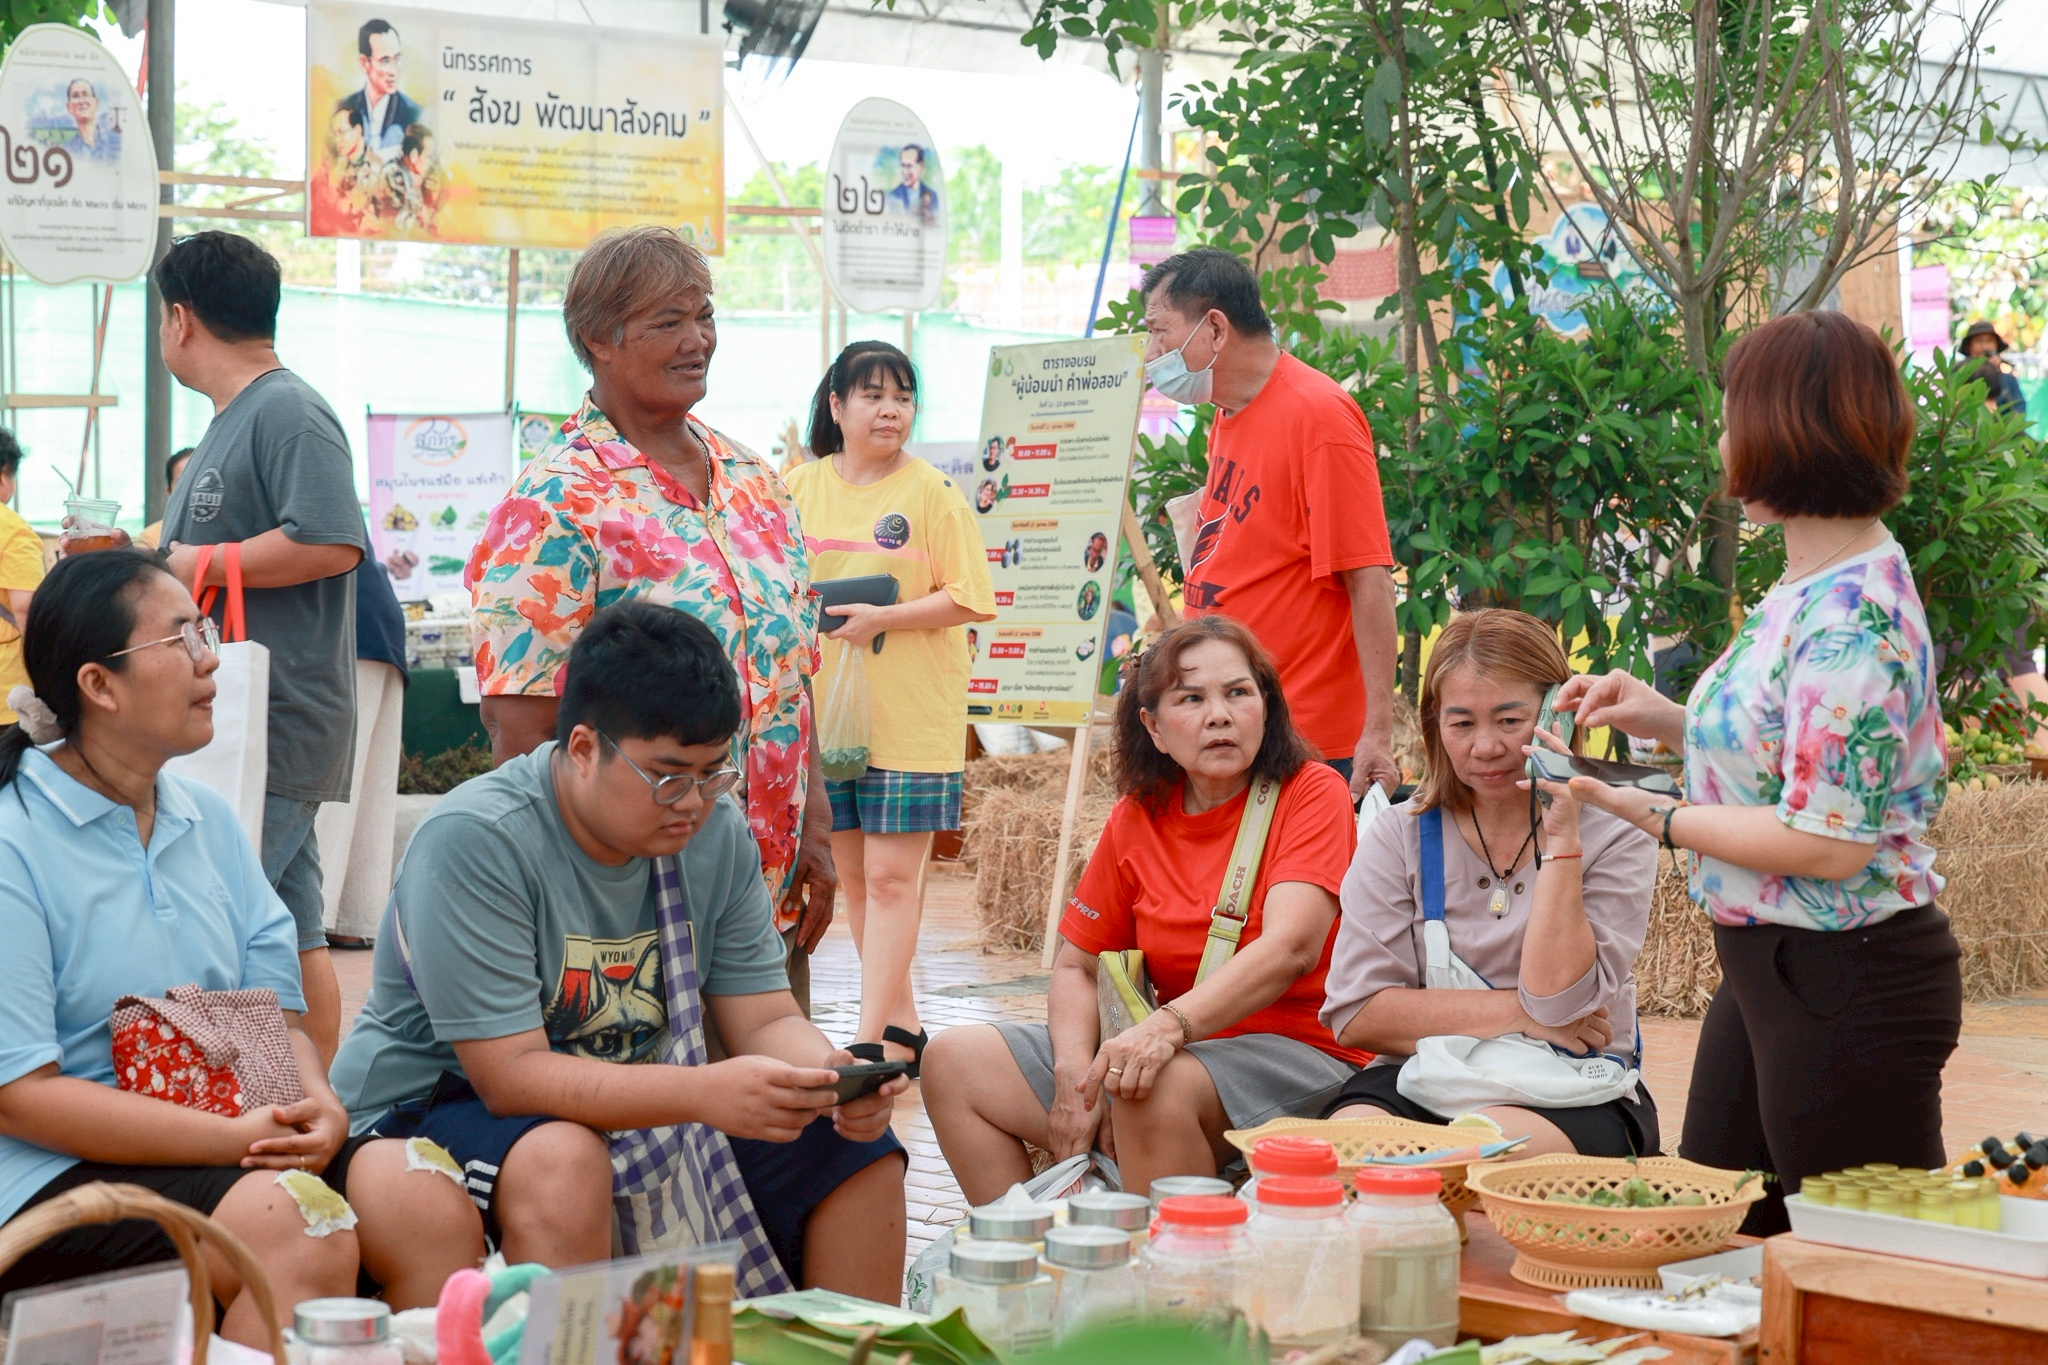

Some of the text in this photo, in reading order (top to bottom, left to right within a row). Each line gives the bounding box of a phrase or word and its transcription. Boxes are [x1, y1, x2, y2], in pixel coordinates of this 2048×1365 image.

[442, 46, 533, 76] นิทรรศการ
[469, 86, 521, 126] สังฆ
[535, 91, 688, 138] พัฒนาสังคม
[833, 173, 885, 215] ๒๒
[1042, 355, 1096, 370] ตารางอบรม
